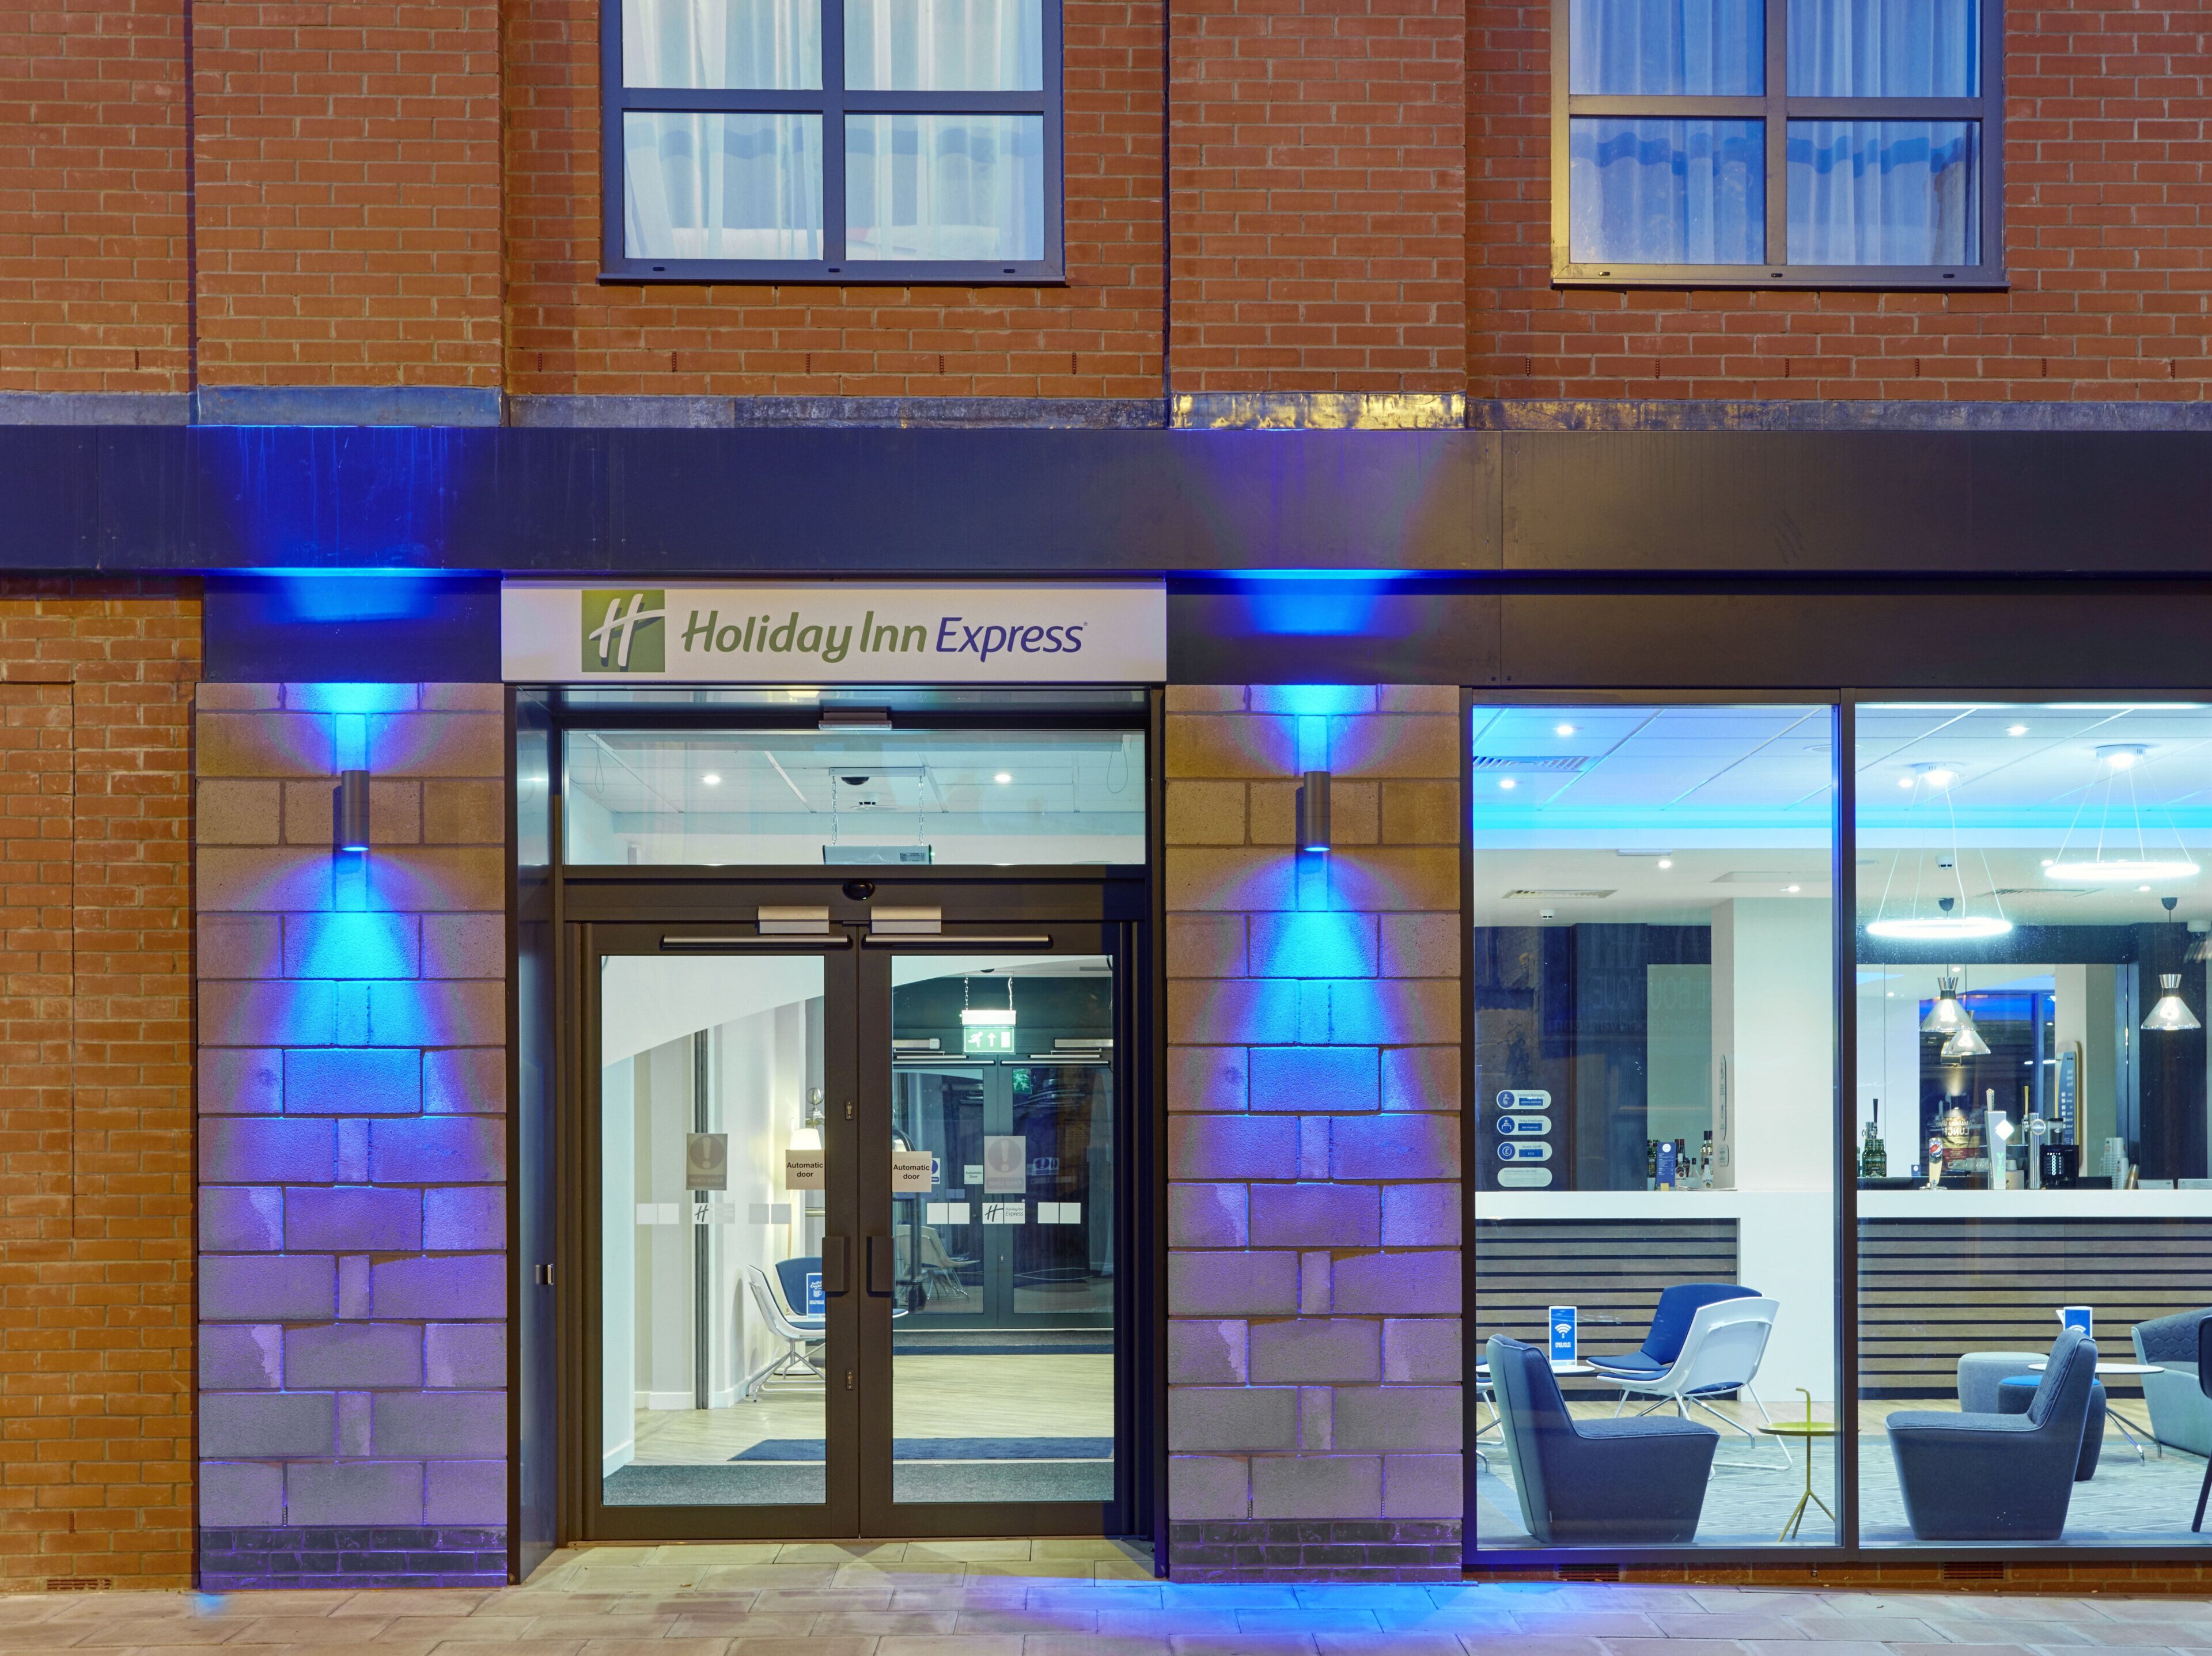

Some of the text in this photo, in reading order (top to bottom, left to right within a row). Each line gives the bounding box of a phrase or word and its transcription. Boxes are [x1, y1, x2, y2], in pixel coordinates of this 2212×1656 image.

[681, 610, 1084, 663] Holiday Inn Express
